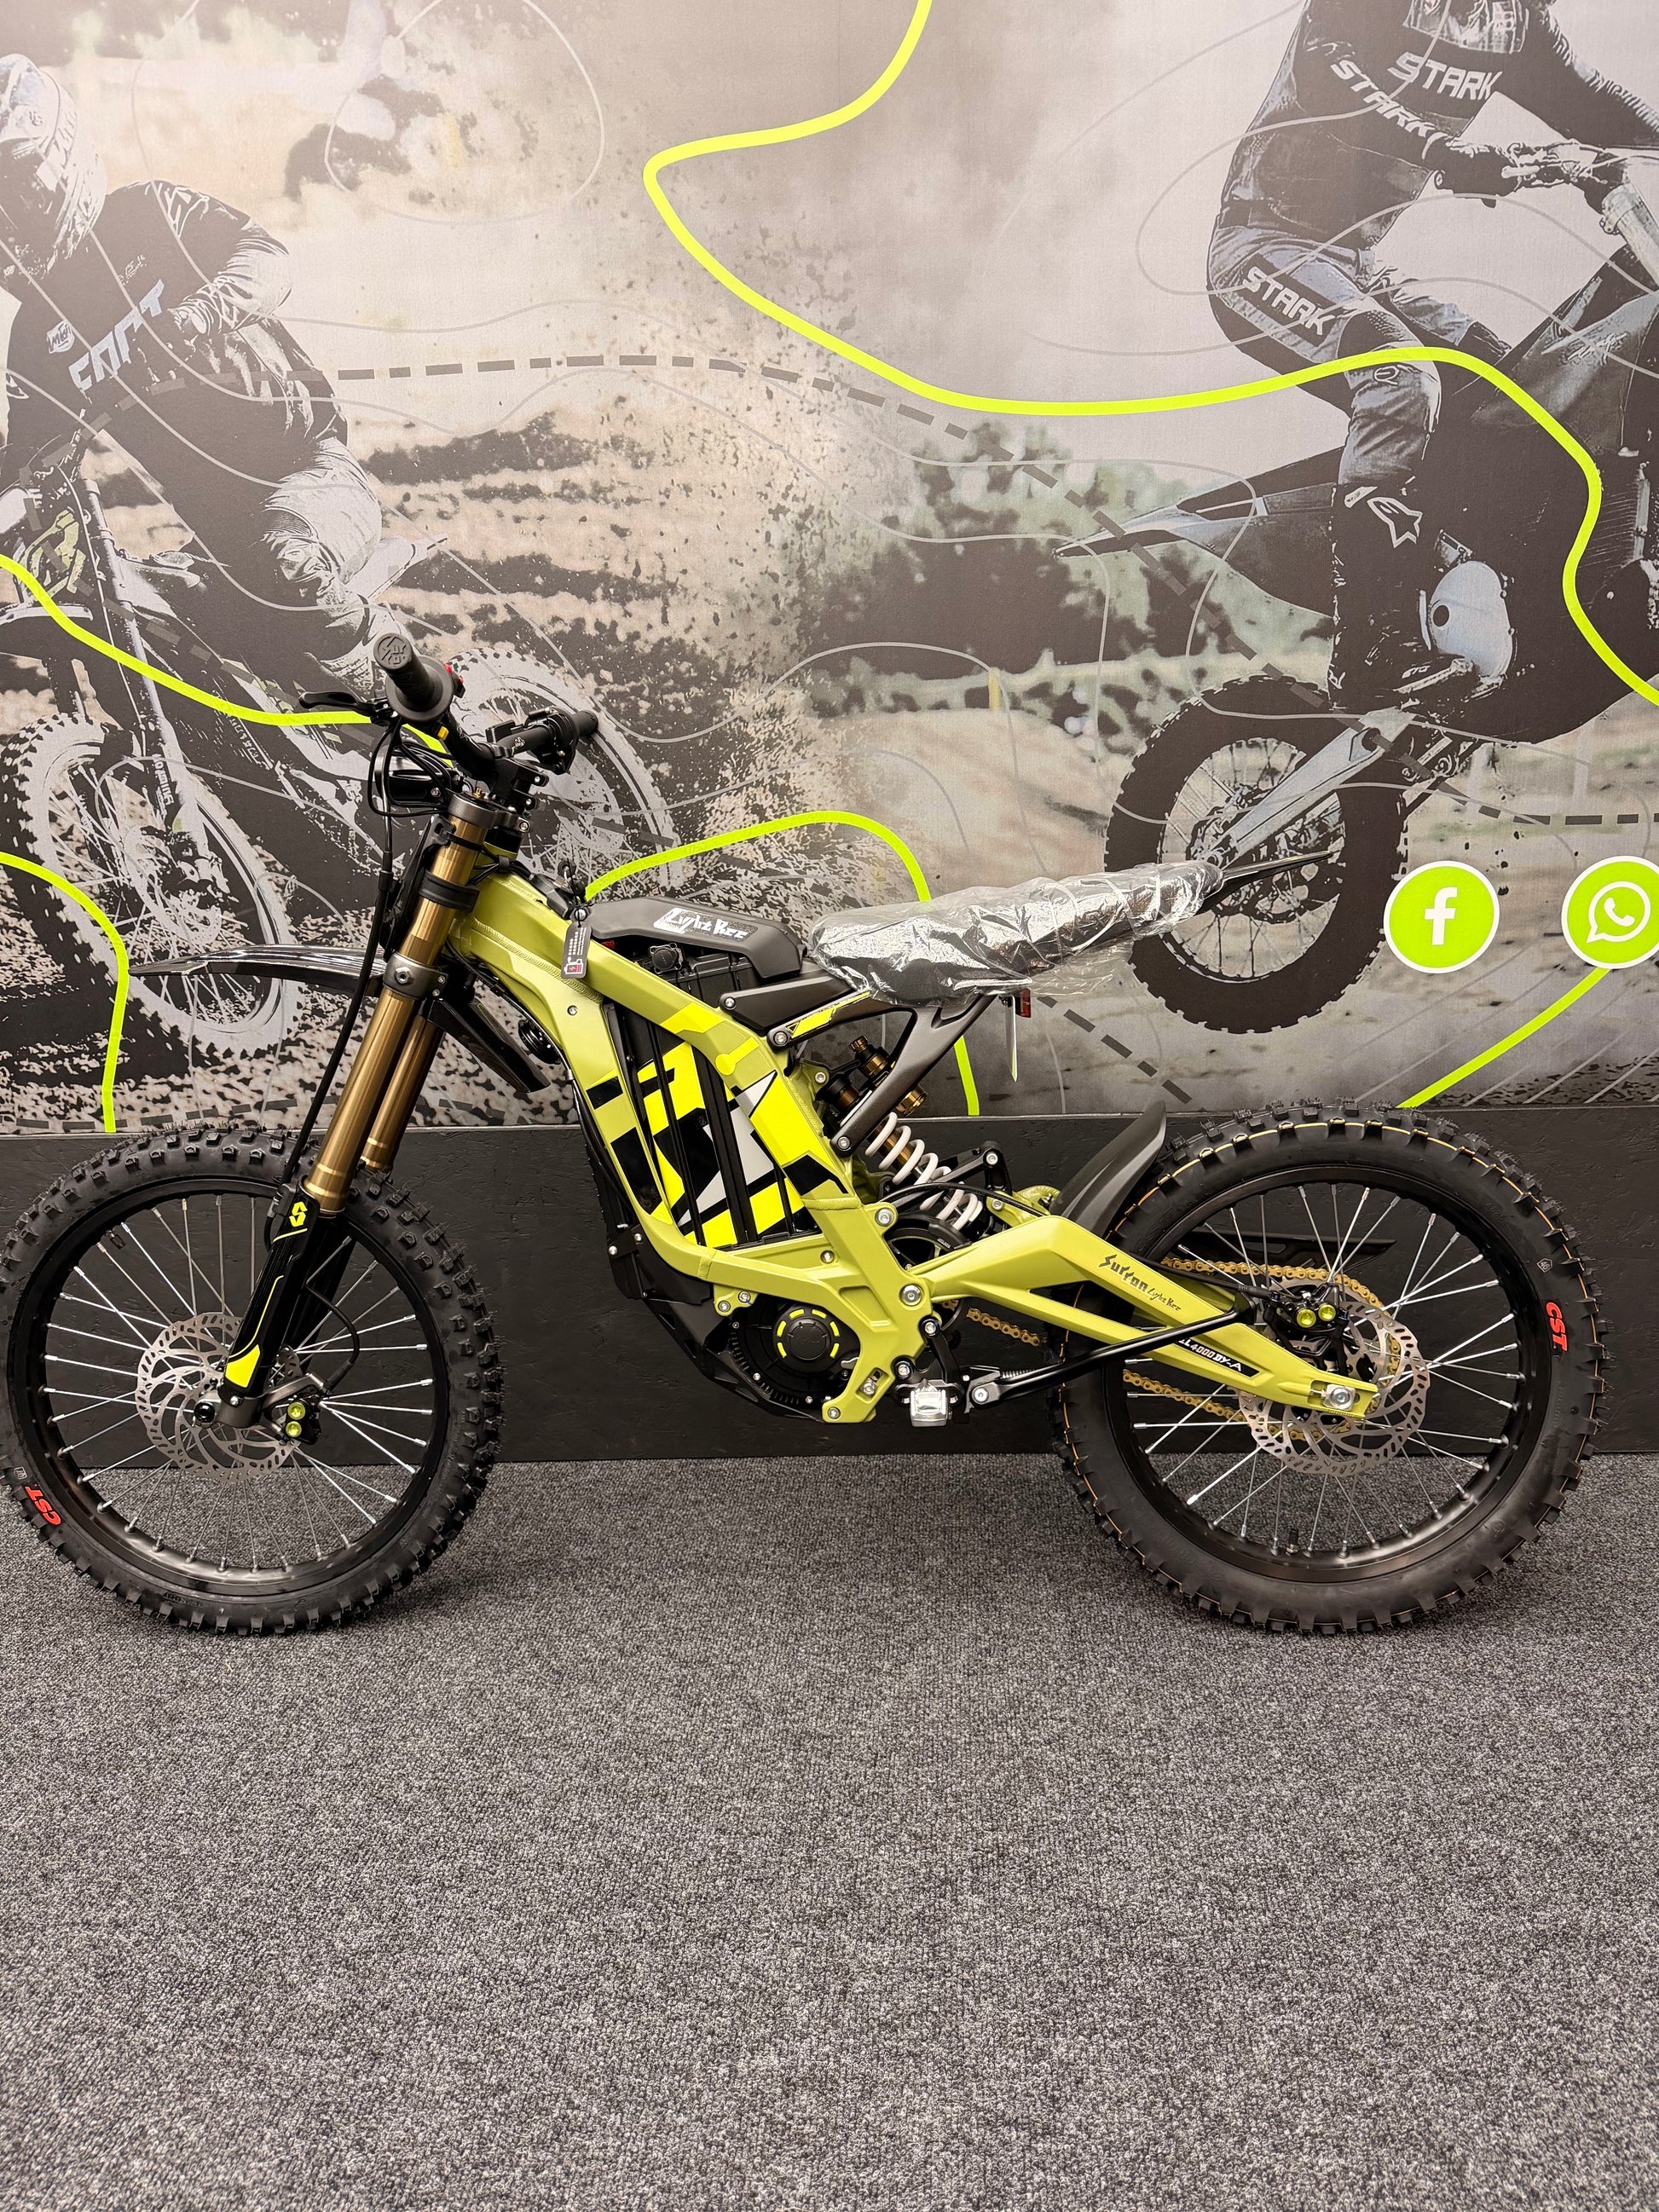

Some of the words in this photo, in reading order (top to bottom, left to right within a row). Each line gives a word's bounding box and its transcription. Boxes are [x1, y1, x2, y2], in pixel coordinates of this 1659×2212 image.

[1331, 60, 1436, 136] STARK
[1387, 52, 1502, 100] STARK
[1243, 266, 1335, 335] STARK
[1546, 1302, 1567, 1352] CST
[24, 1486, 61, 1526] CST
